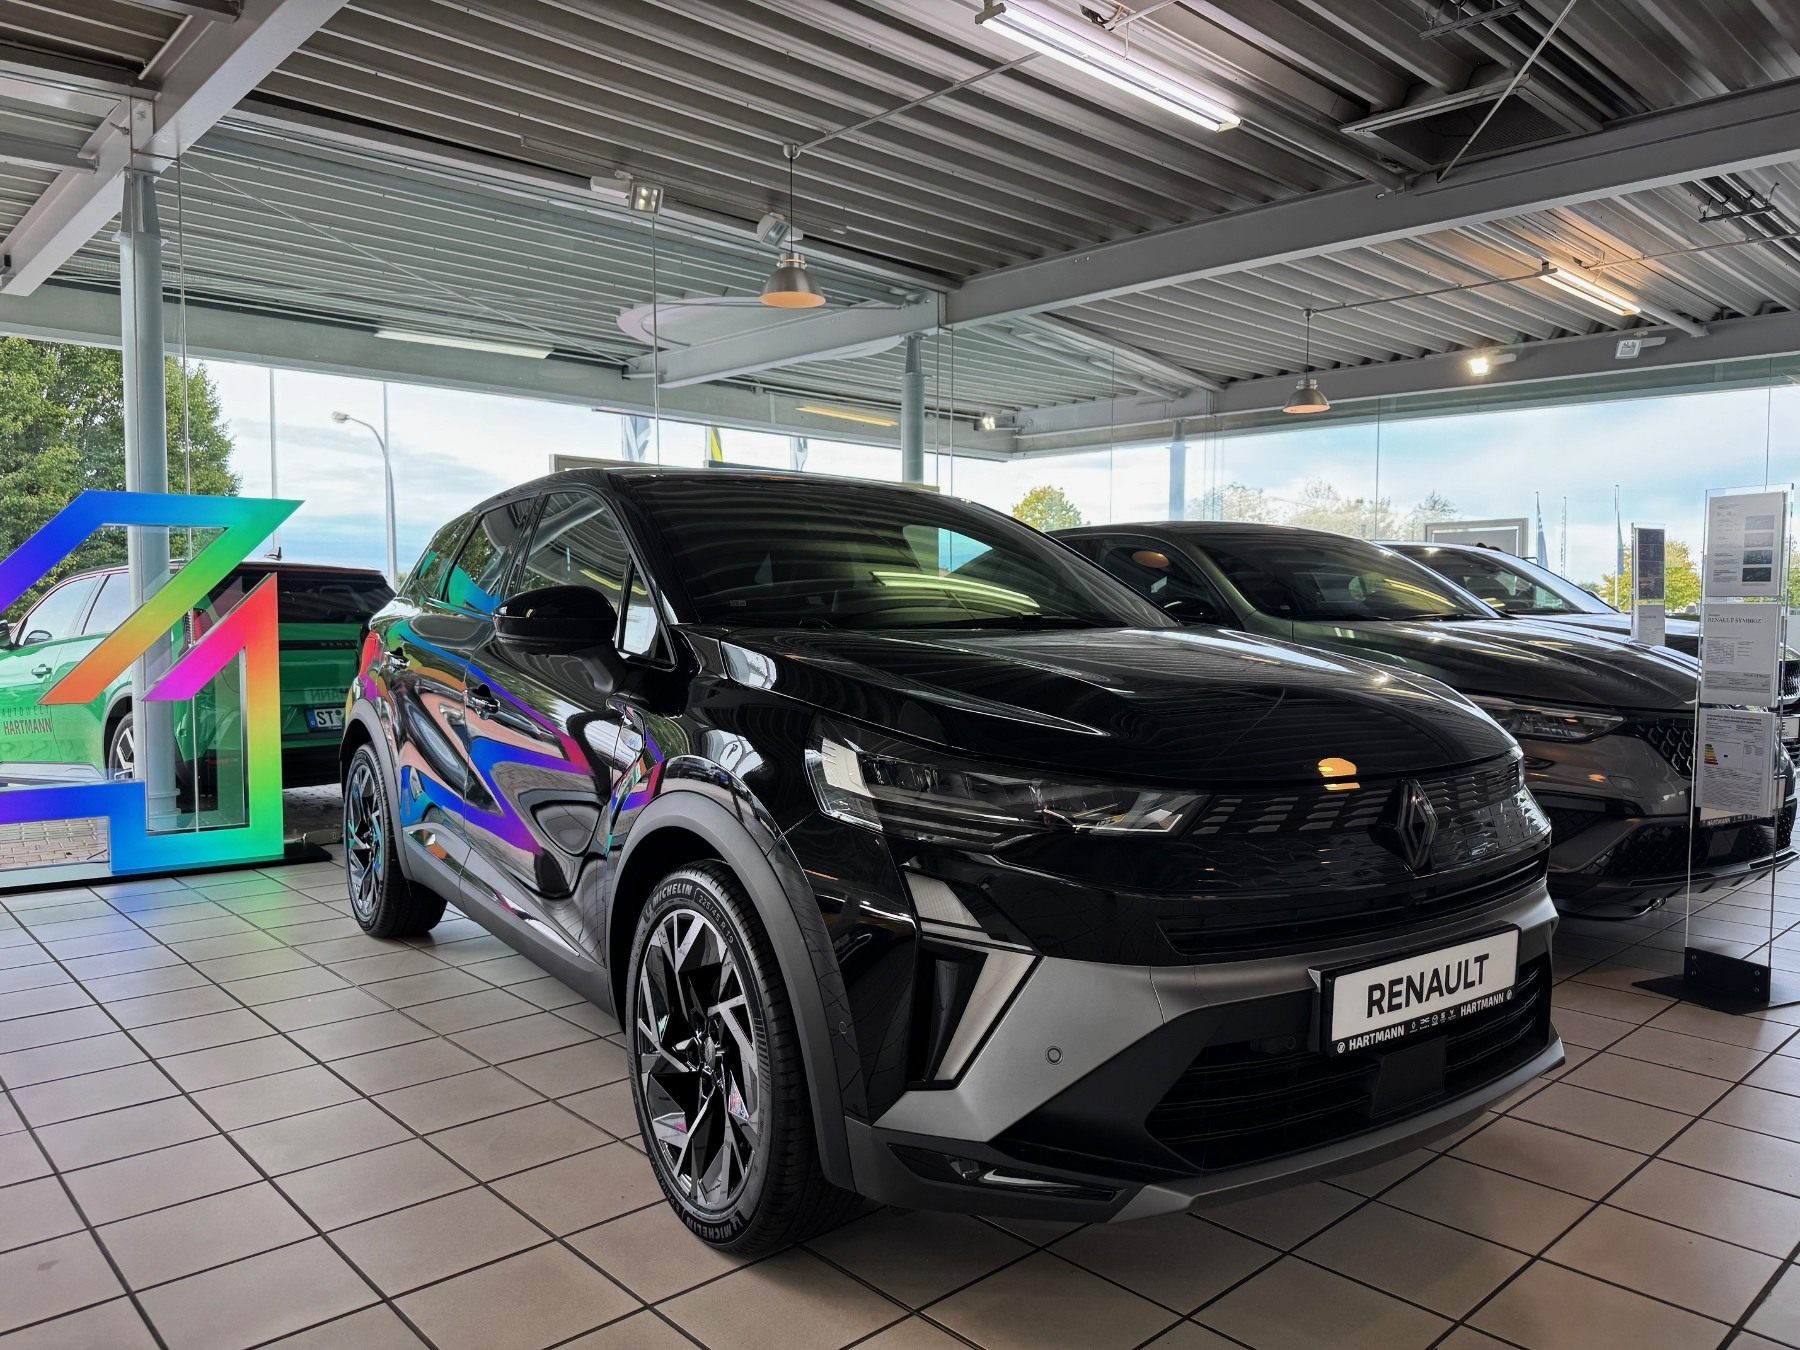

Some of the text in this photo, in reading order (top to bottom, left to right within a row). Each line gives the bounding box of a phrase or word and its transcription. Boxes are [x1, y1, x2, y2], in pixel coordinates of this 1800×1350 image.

[3, 718, 53, 736] HARTMANN
[316, 710, 334, 726] ST
[653, 883, 693, 907] MICHELIN
[698, 895, 720, 920] 225/45
[1366, 953, 1490, 1019] RENAULT
[1460, 993, 1504, 1017] HARTMANN
[1349, 1025, 1405, 1052] HARTMANN
[686, 1216, 732, 1240] MICHELIN
